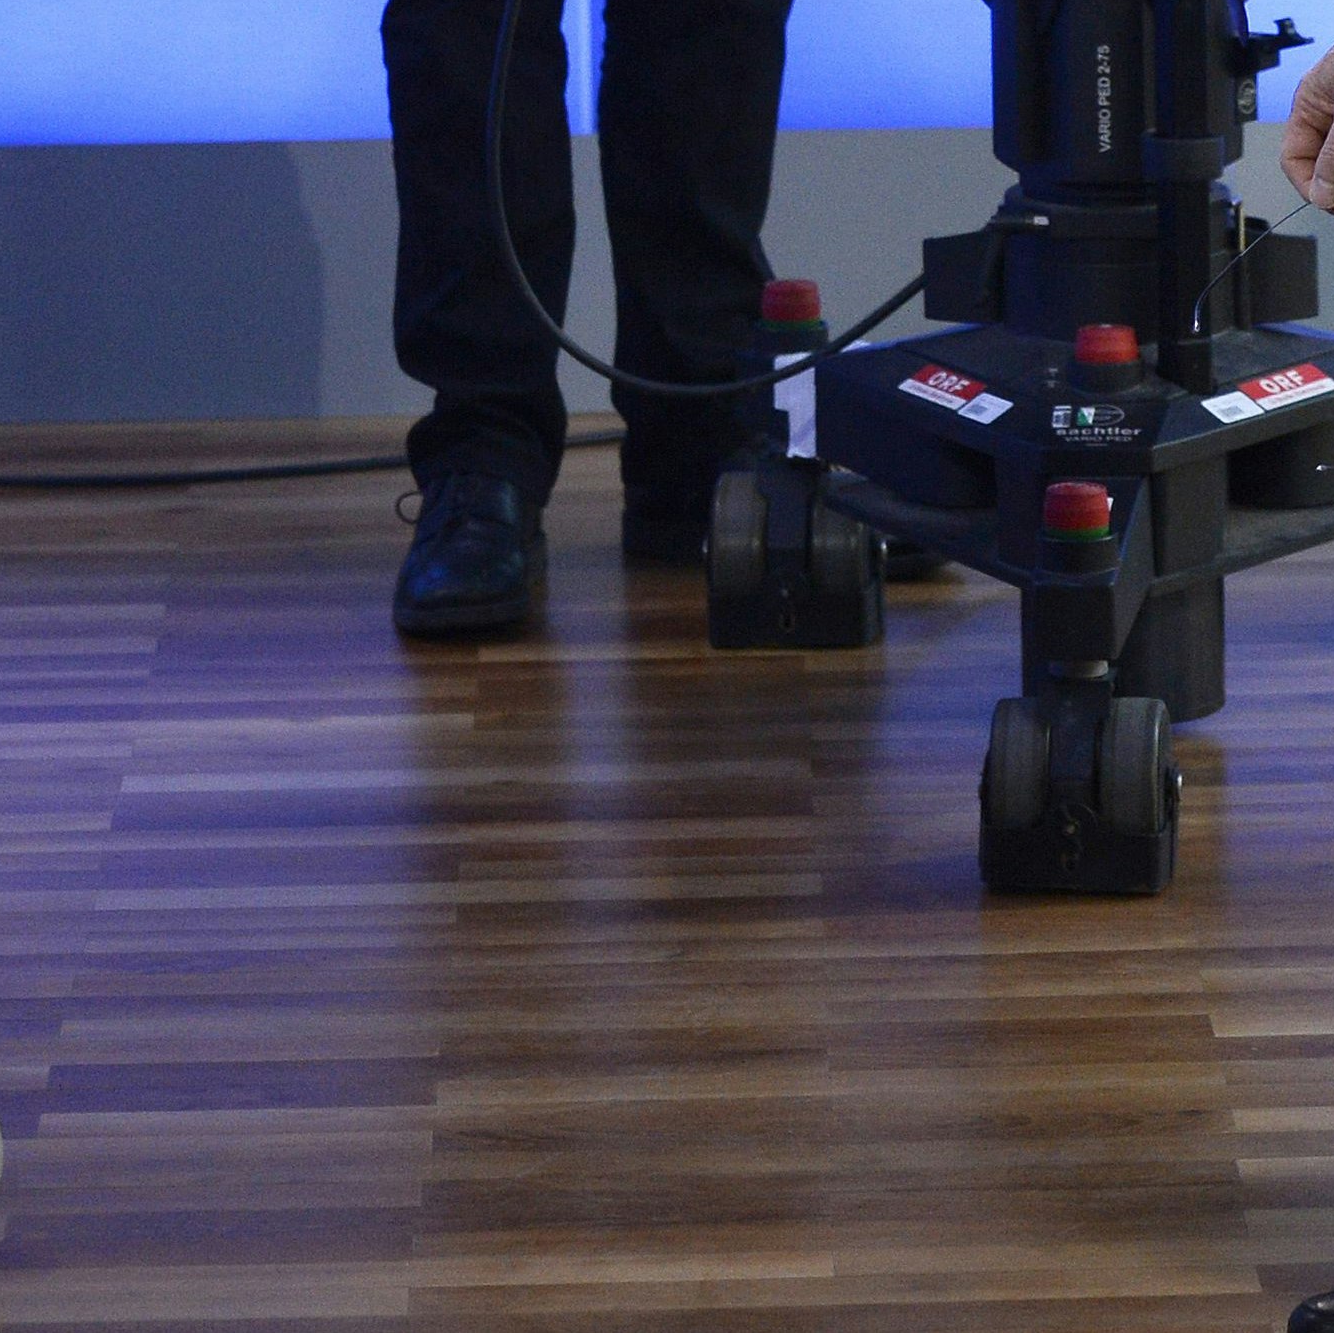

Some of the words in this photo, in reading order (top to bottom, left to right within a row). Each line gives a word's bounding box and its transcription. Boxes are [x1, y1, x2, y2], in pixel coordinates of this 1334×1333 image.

[1097, 76, 1112, 106] PED
[1098, 108, 1112, 153] VARIO
[928, 370, 971, 393] ORF
[1259, 368, 1305, 394] ORF
[1056, 427, 1142, 436] sachtler
